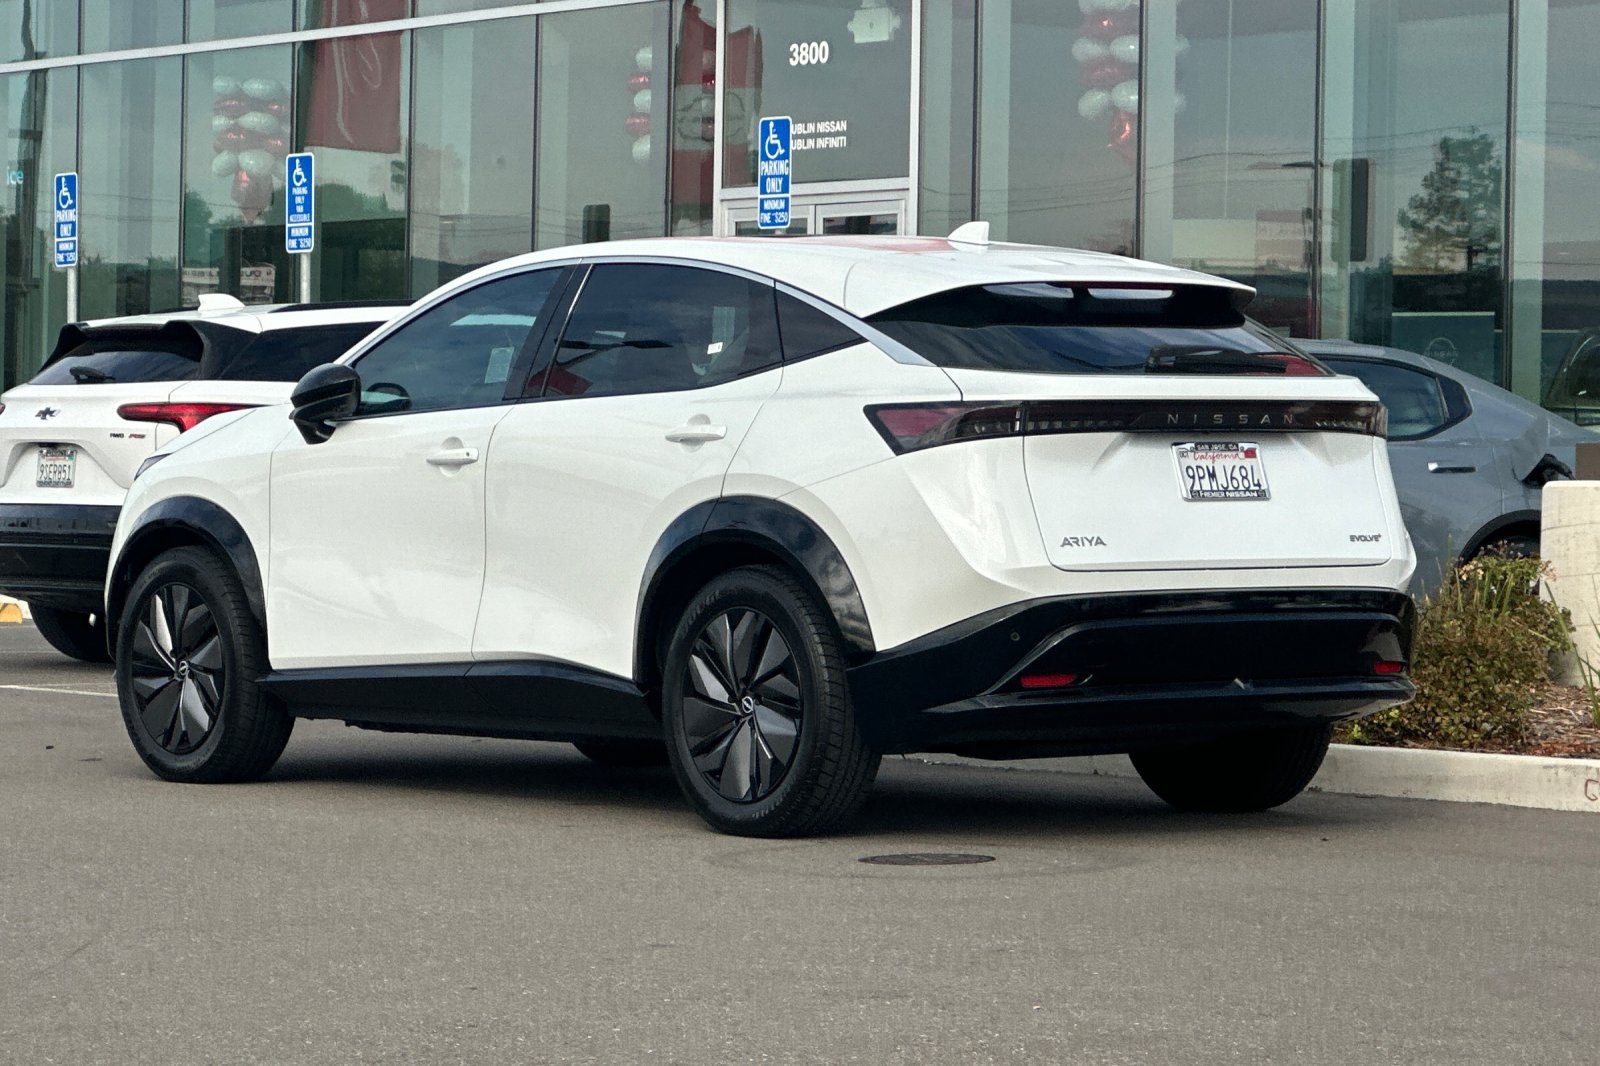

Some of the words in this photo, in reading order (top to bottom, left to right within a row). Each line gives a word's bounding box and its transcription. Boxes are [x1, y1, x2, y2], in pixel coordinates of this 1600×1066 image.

[789, 41, 829, 66] 3800
[791, 123, 815, 134] UBLIN
[816, 120, 847, 132] NISSAN
[791, 138, 815, 150] UBLIN
[816, 136, 847, 148] INFINITI
[761, 160, 789, 176] PARKING
[766, 177, 783, 193] ONLY
[763, 199, 785, 210] MINIMUM
[56, 209, 76, 222] PARKING
[761, 212, 772, 223] FINE
[60, 224, 72, 237] ONLY
[1167, 414, 1293, 424] NISSAN
[1193, 451, 1239, 464] California
[40, 464, 71, 481] 9SER851
[1185, 465, 1262, 490] 9PMJ684
[1226, 490, 1258, 498] NISSAN
[1060, 536, 1107, 547] ARIYA
